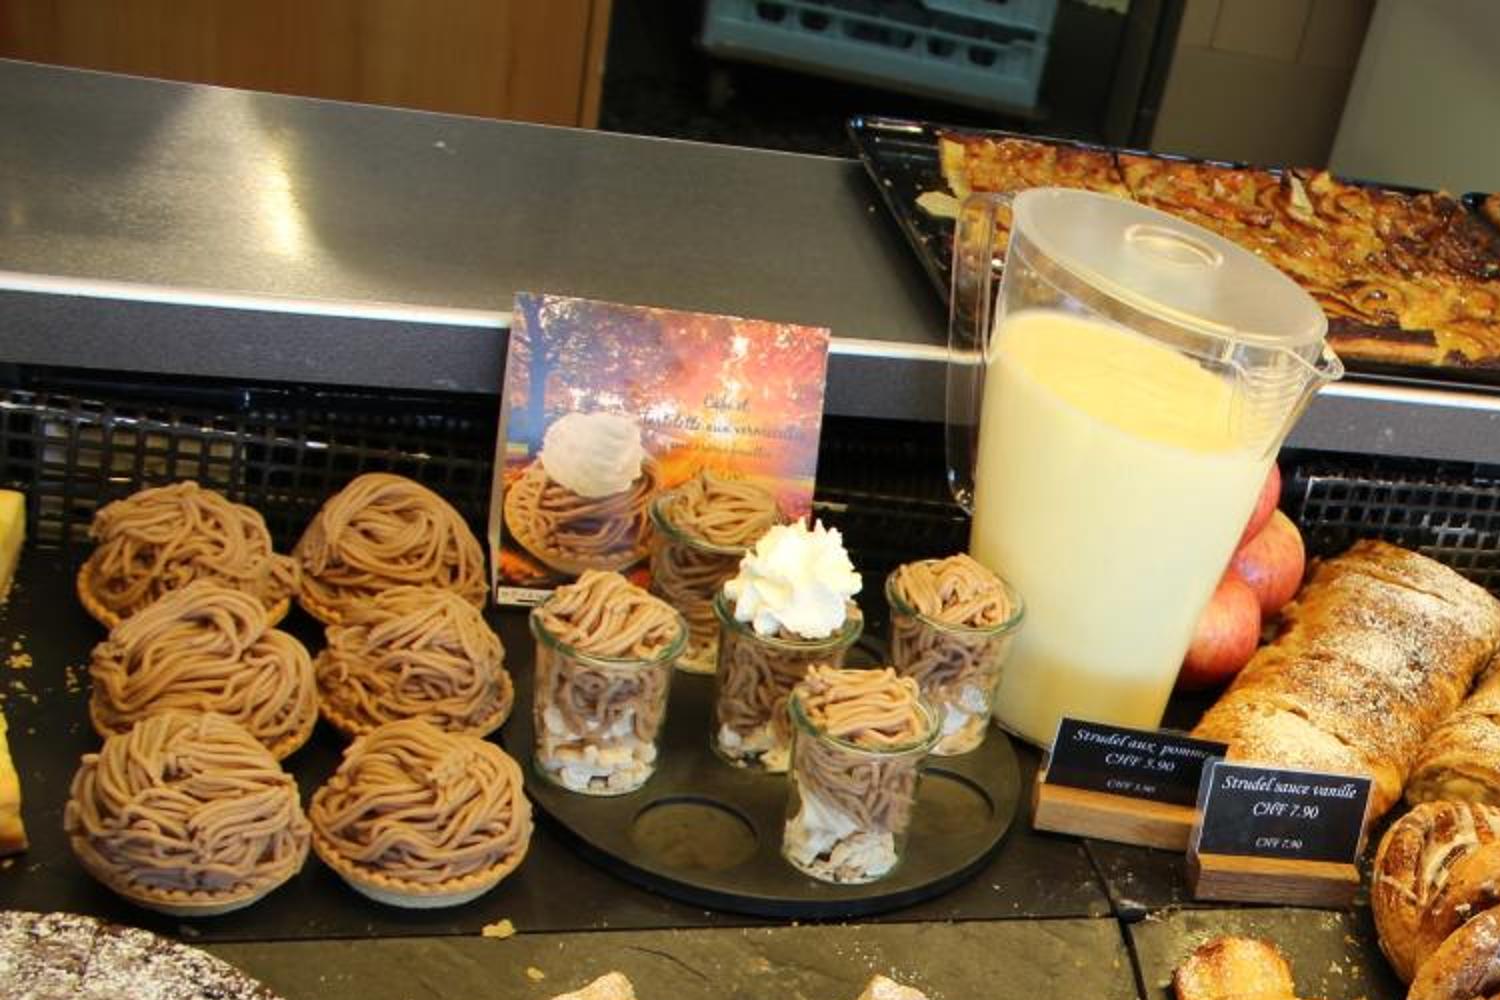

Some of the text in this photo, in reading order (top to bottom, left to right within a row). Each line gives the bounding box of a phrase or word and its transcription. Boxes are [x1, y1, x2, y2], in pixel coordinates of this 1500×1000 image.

[1073, 729, 1130, 746] Strudel
[1105, 752, 1140, 767] CHF
[1221, 774, 1358, 799] Strudel sauce vanille
[1252, 800, 1319, 820] CHF 7.90
